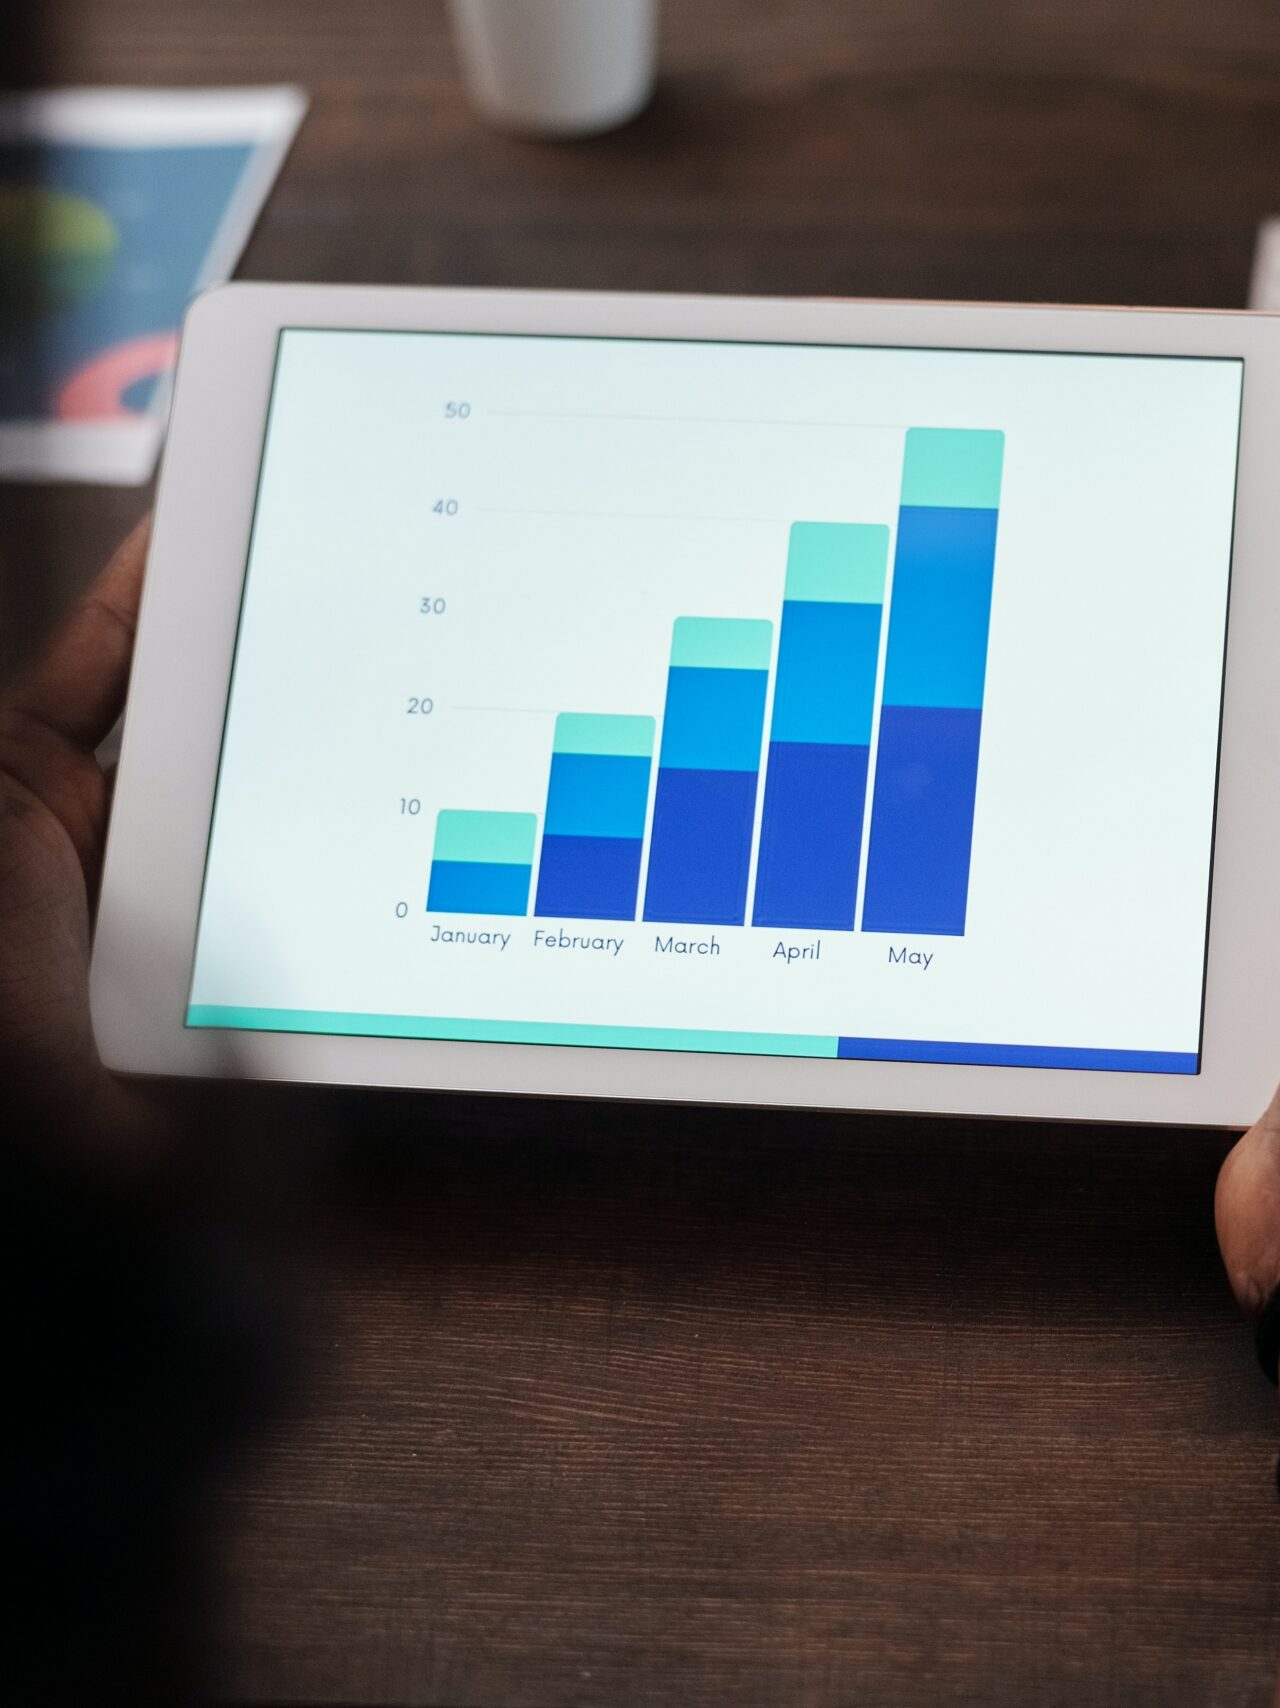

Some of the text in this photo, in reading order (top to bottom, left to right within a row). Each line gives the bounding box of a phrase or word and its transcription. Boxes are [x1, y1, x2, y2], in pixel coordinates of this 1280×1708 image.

[444, 400, 471, 419] 50
[432, 499, 458, 515] 40
[419, 596, 446, 614] 30
[406, 696, 433, 714] 20
[400, 797, 421, 815] 10
[395, 901, 408, 918] 0
[430, 924, 933, 970] January February March April May
